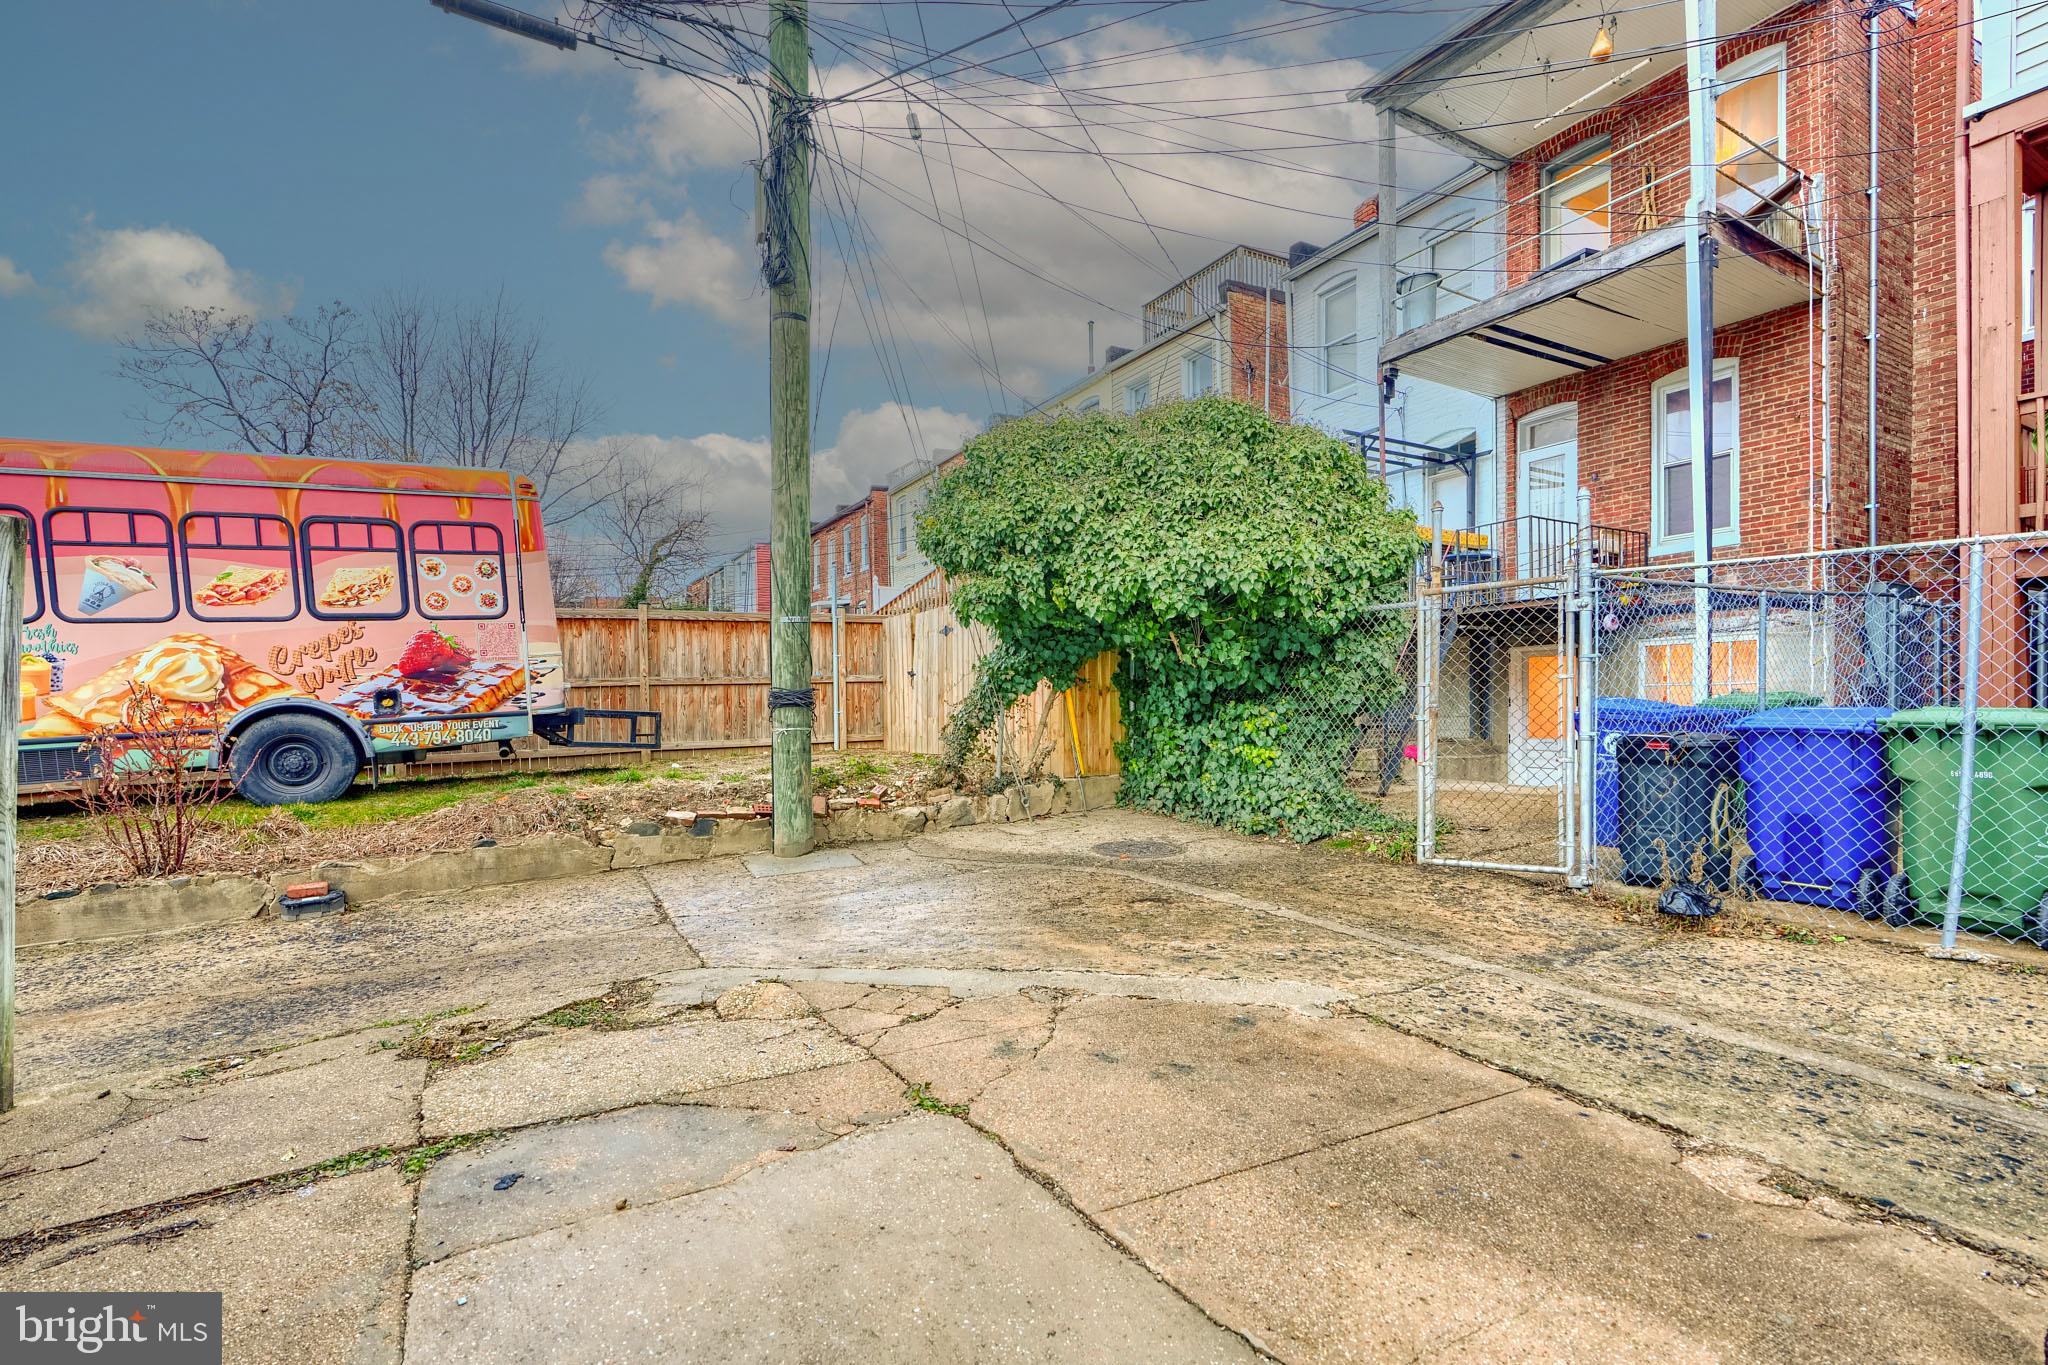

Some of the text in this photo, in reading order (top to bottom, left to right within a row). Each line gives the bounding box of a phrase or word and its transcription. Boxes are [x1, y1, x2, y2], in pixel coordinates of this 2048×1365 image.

[22, 624, 57, 640] resh
[380, 719, 500, 734] BOOK US FOR YOUR EVENT
[391, 728, 492, 747] 443-794-8040
